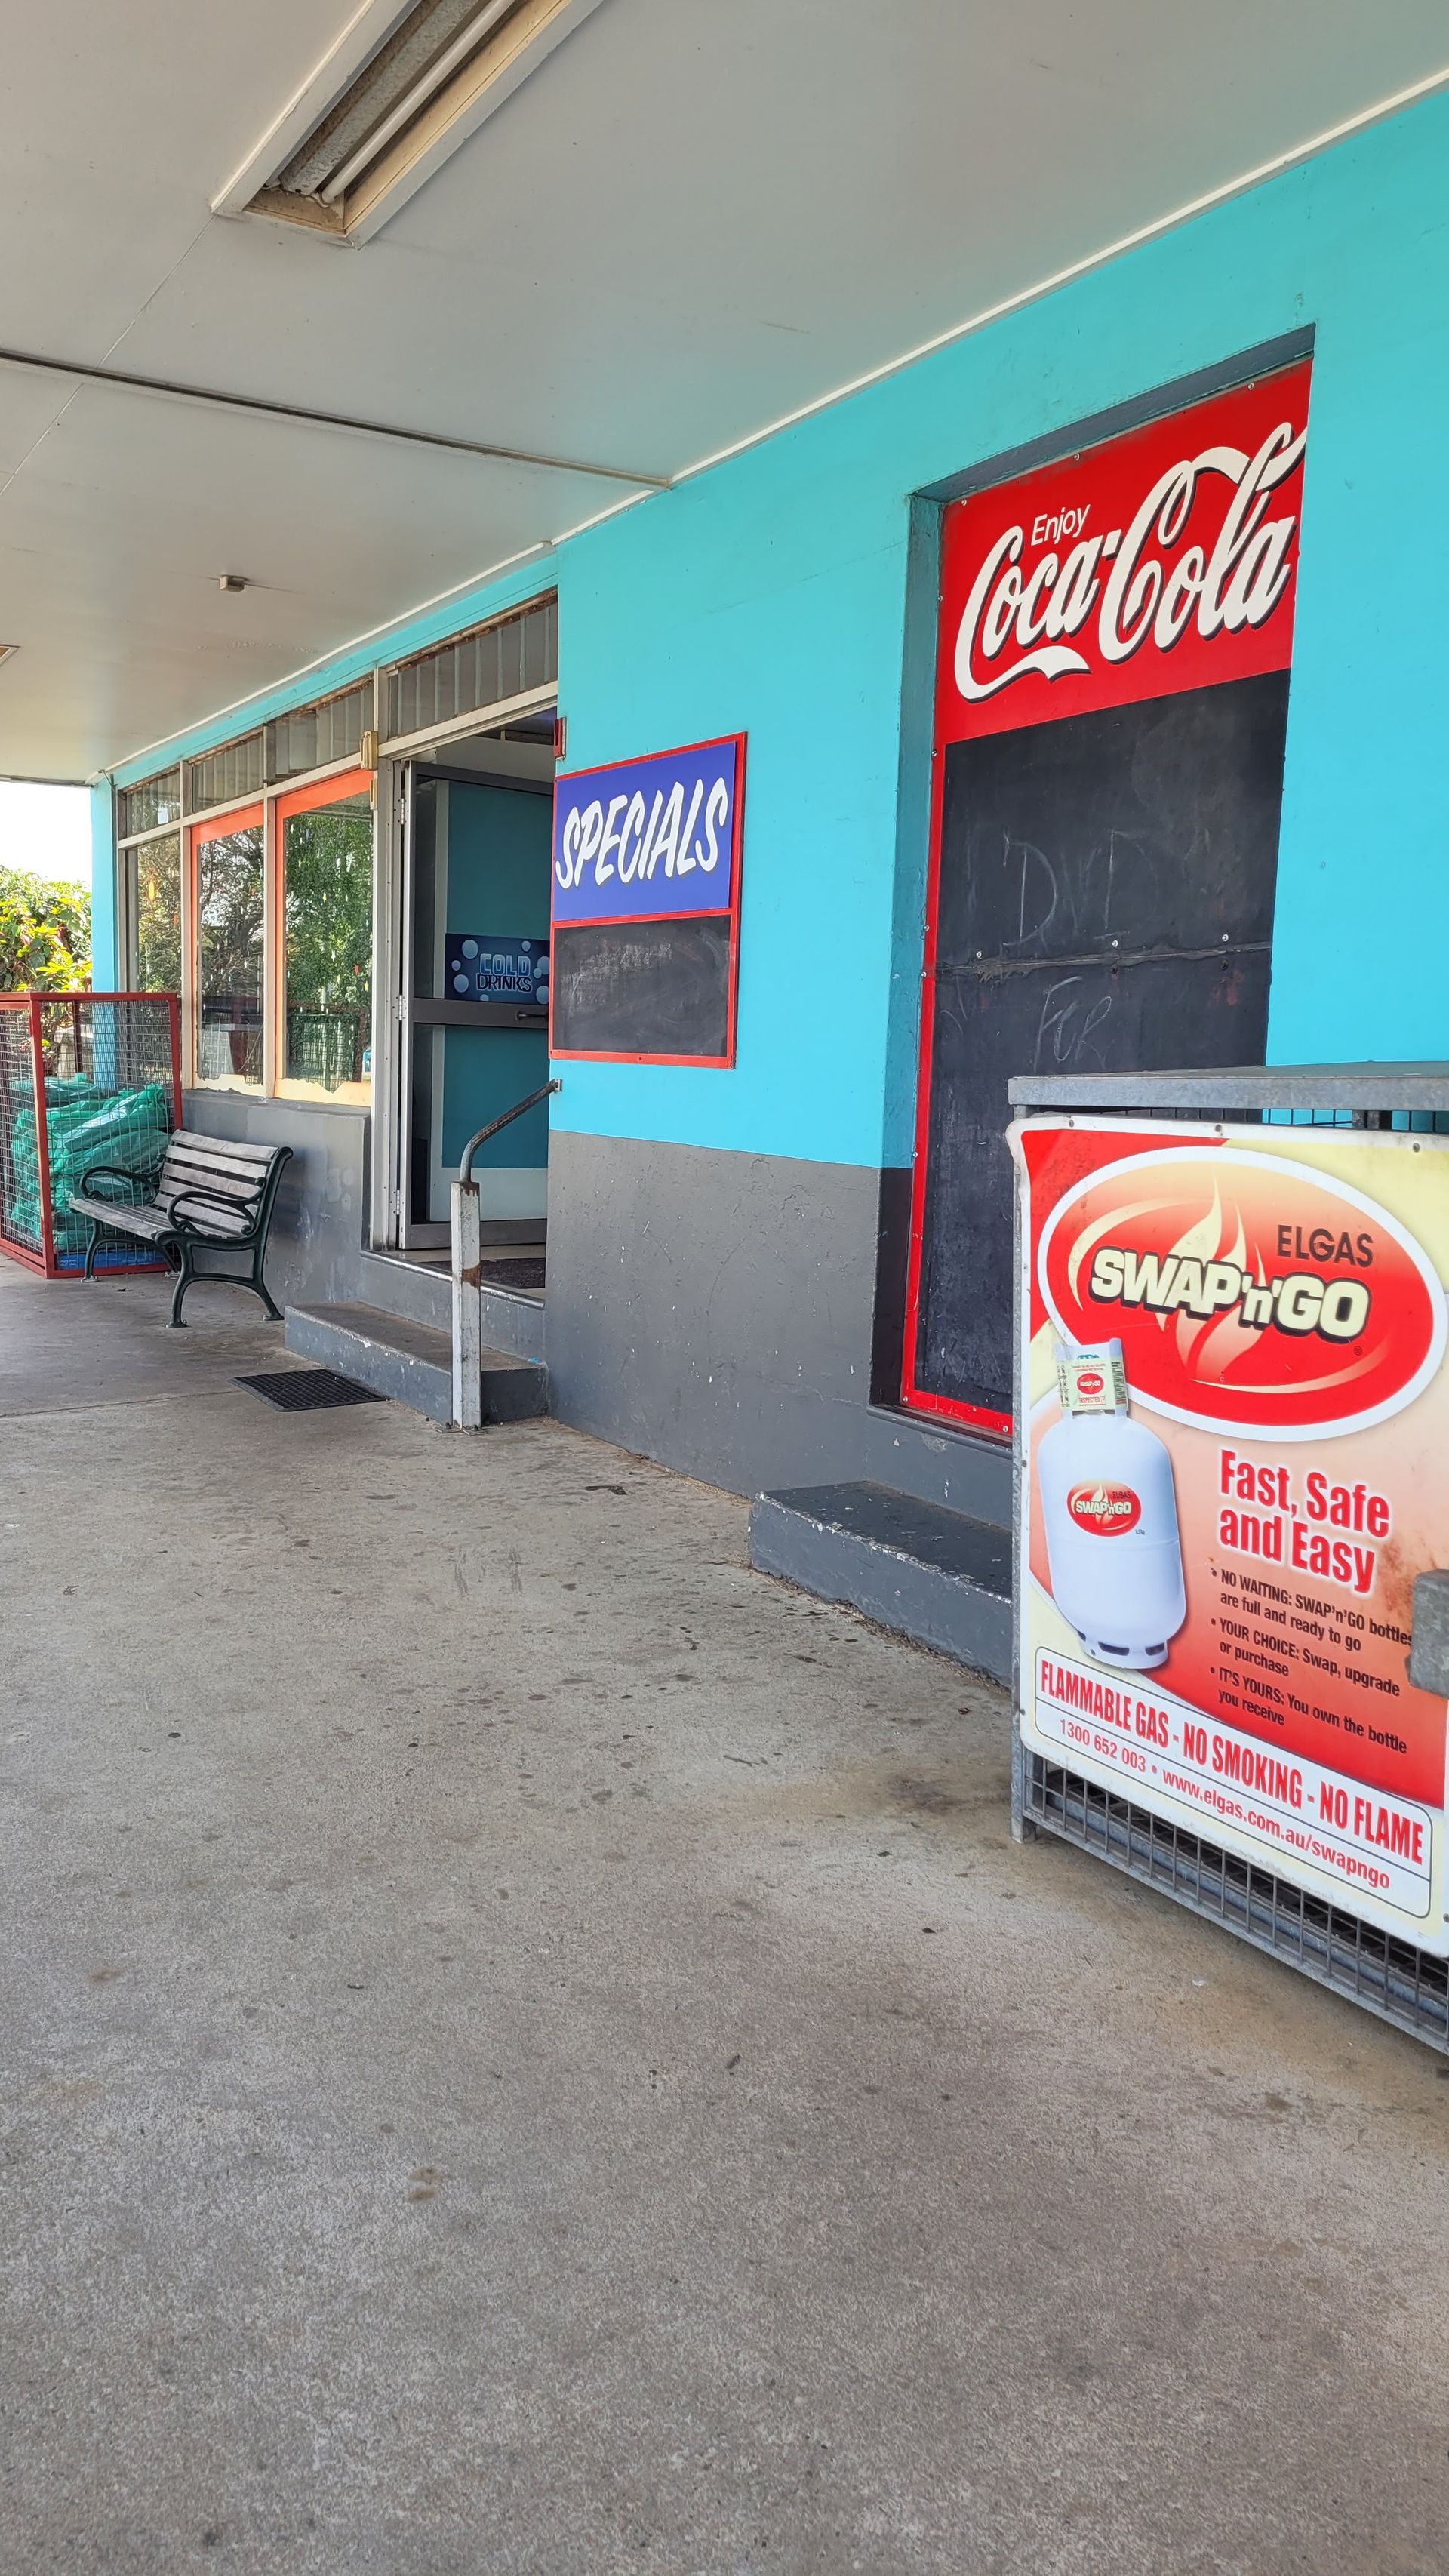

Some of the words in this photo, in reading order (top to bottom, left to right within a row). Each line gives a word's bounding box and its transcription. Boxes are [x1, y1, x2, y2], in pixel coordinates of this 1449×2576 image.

[1031, 504, 1091, 546] Enjoy
[955, 422, 1308, 703] Coca-Cola
[555, 777, 728, 890] SPECIALS
[476, 973, 532, 993] DRINKS
[479, 953, 531, 977] COLD
[1277, 1224, 1374, 1268] ELGAS
[1220, 1450, 1297, 1518] Fast,
[1306, 1472, 1389, 1537] Safe
[1220, 1509, 1281, 1561] and
[1291, 1521, 1374, 1593] Easy
[1221, 1569, 1237, 1587] NO
[1239, 1575, 1291, 1605] WAITING:
[1220, 1594, 1238, 1608] are
[1242, 1596, 1260, 1614] full
[1264, 1608, 1286, 1625] and
[1290, 1617, 1324, 1642] ready
[1328, 1626, 1341, 1644] to
[1346, 1638, 1361, 1651] go
[1219, 1617, 1249, 1641] YOUR
[1253, 1630, 1299, 1660] CHOICE:
[1303, 1648, 1341, 1678] Swap,
[1345, 1667, 1400, 1697] upgrade
[1220, 1643, 1232, 1654] or
[1235, 1646, 1289, 1676] purchase
[1218, 1689, 1238, 1709] you
[1242, 1697, 1284, 1726] receive
[1219, 1667, 1239, 1687] IT'S
[1242, 1674, 1284, 1705] YOURS:
[1287, 1694, 1309, 1714] You
[1312, 1708, 1339, 1728] own
[1343, 1715, 1364, 1737] the
[1367, 1727, 1407, 1755] bottle
[1041, 1660, 1131, 1731] FLAMMABLE
[1135, 1701, 1169, 1749] GAS
[1183, 1722, 1207, 1765] NO
[1211, 1742, 1303, 1809] SMOKING
[1319, 1781, 1347, 1830] NO
[1354, 1793, 1423, 1865] FLAME
[1060, 1719, 1090, 1746] 1300
[1094, 1735, 1118, 1759] 652
[1121, 1751, 1146, 1773] 003
[1162, 1768, 1390, 1889] www.elgas.com.au/swapngo
